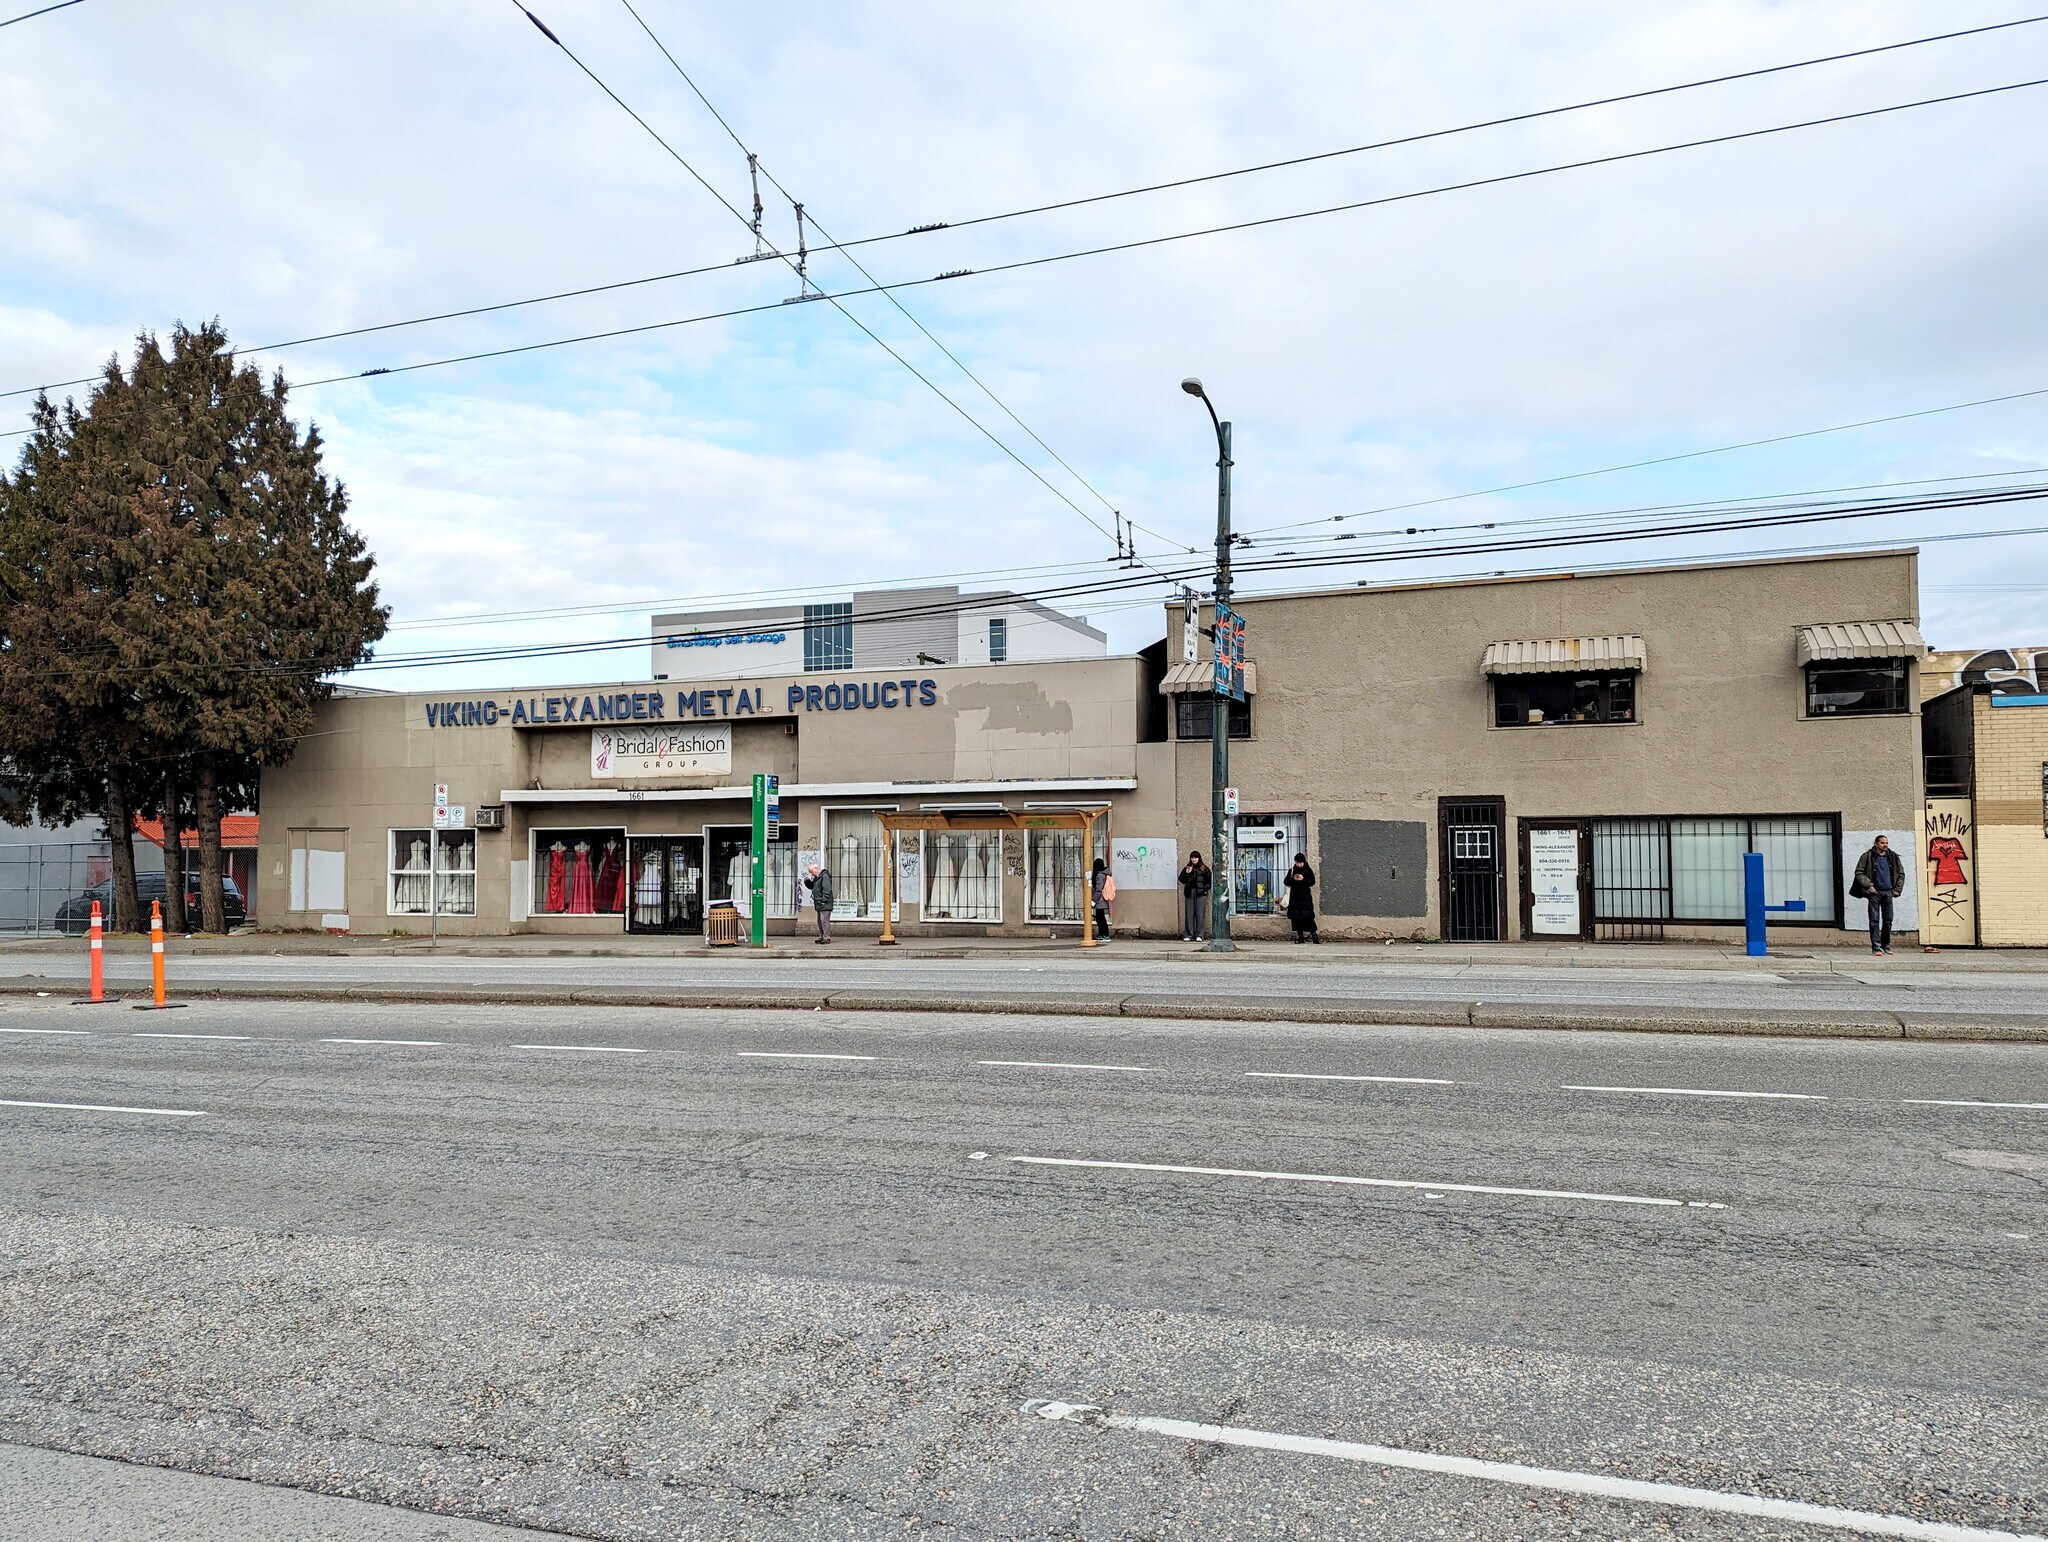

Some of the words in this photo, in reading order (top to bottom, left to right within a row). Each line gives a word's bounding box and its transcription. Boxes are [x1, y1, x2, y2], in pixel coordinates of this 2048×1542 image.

[425, 692, 665, 727] VIKING-ALEXANDER
[787, 679, 938, 713] PRODUCTS
[643, 760, 698, 769] GROUP
[629, 792, 644, 800] 1661
